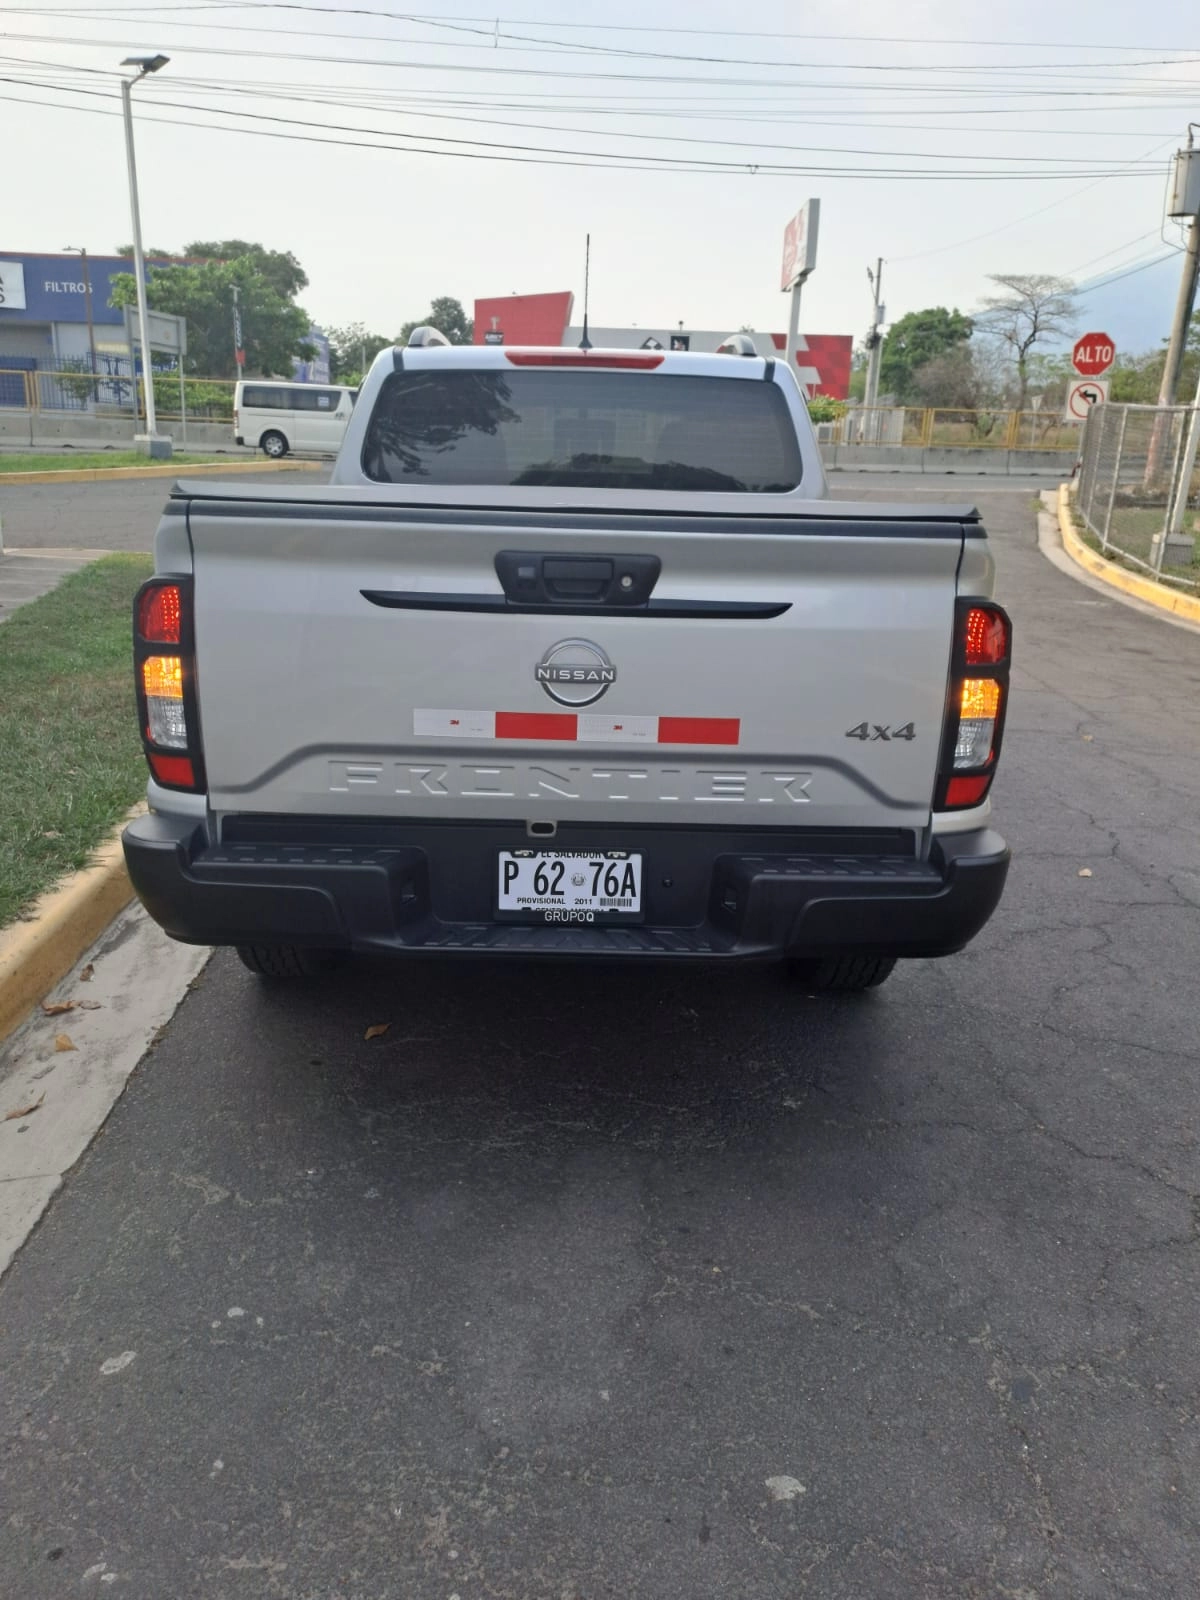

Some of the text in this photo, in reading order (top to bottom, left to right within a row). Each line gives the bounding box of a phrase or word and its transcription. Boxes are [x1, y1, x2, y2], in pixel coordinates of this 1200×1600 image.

[1074, 345, 1112, 363] ALTO
[537, 667, 615, 681] NISSAN
[845, 721, 917, 741] 4x4
[328, 759, 813, 803] FRONTIER
[503, 860, 637, 897] P 62 76A
[516, 896, 593, 905] PROVISIONAL 2011
